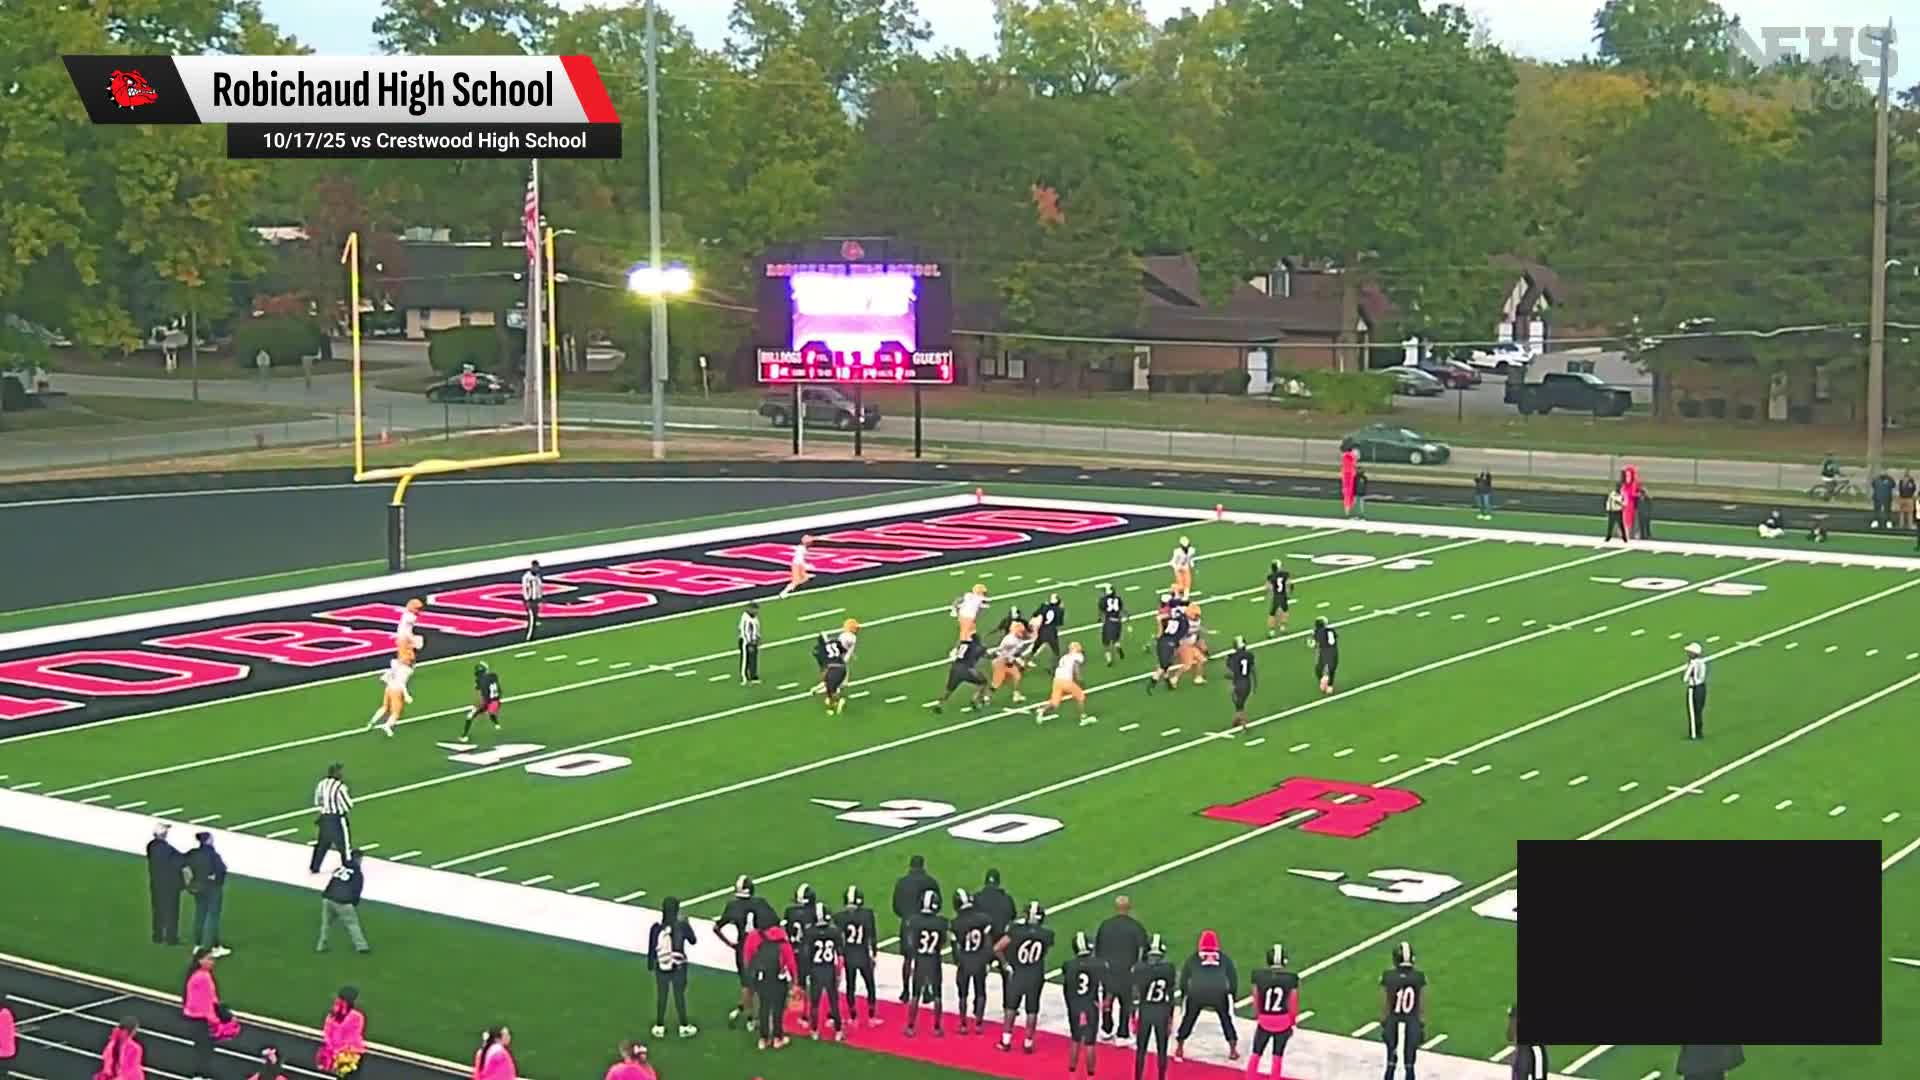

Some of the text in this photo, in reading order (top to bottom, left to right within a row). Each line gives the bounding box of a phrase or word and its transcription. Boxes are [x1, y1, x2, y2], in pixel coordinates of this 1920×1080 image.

[1046, 609, 1056, 625] 9
[1199, 776, 1424, 839] R
[846, 923, 864, 945] 21
[964, 928, 982, 952] 19
[813, 939, 835, 963] 28
[1017, 939, 1043, 964] 60
[1077, 972, 1090, 995] 3
[1146, 979, 1167, 1002] 13
[1264, 987, 1284, 1012] 12
[1394, 986, 1415, 1013] 10
